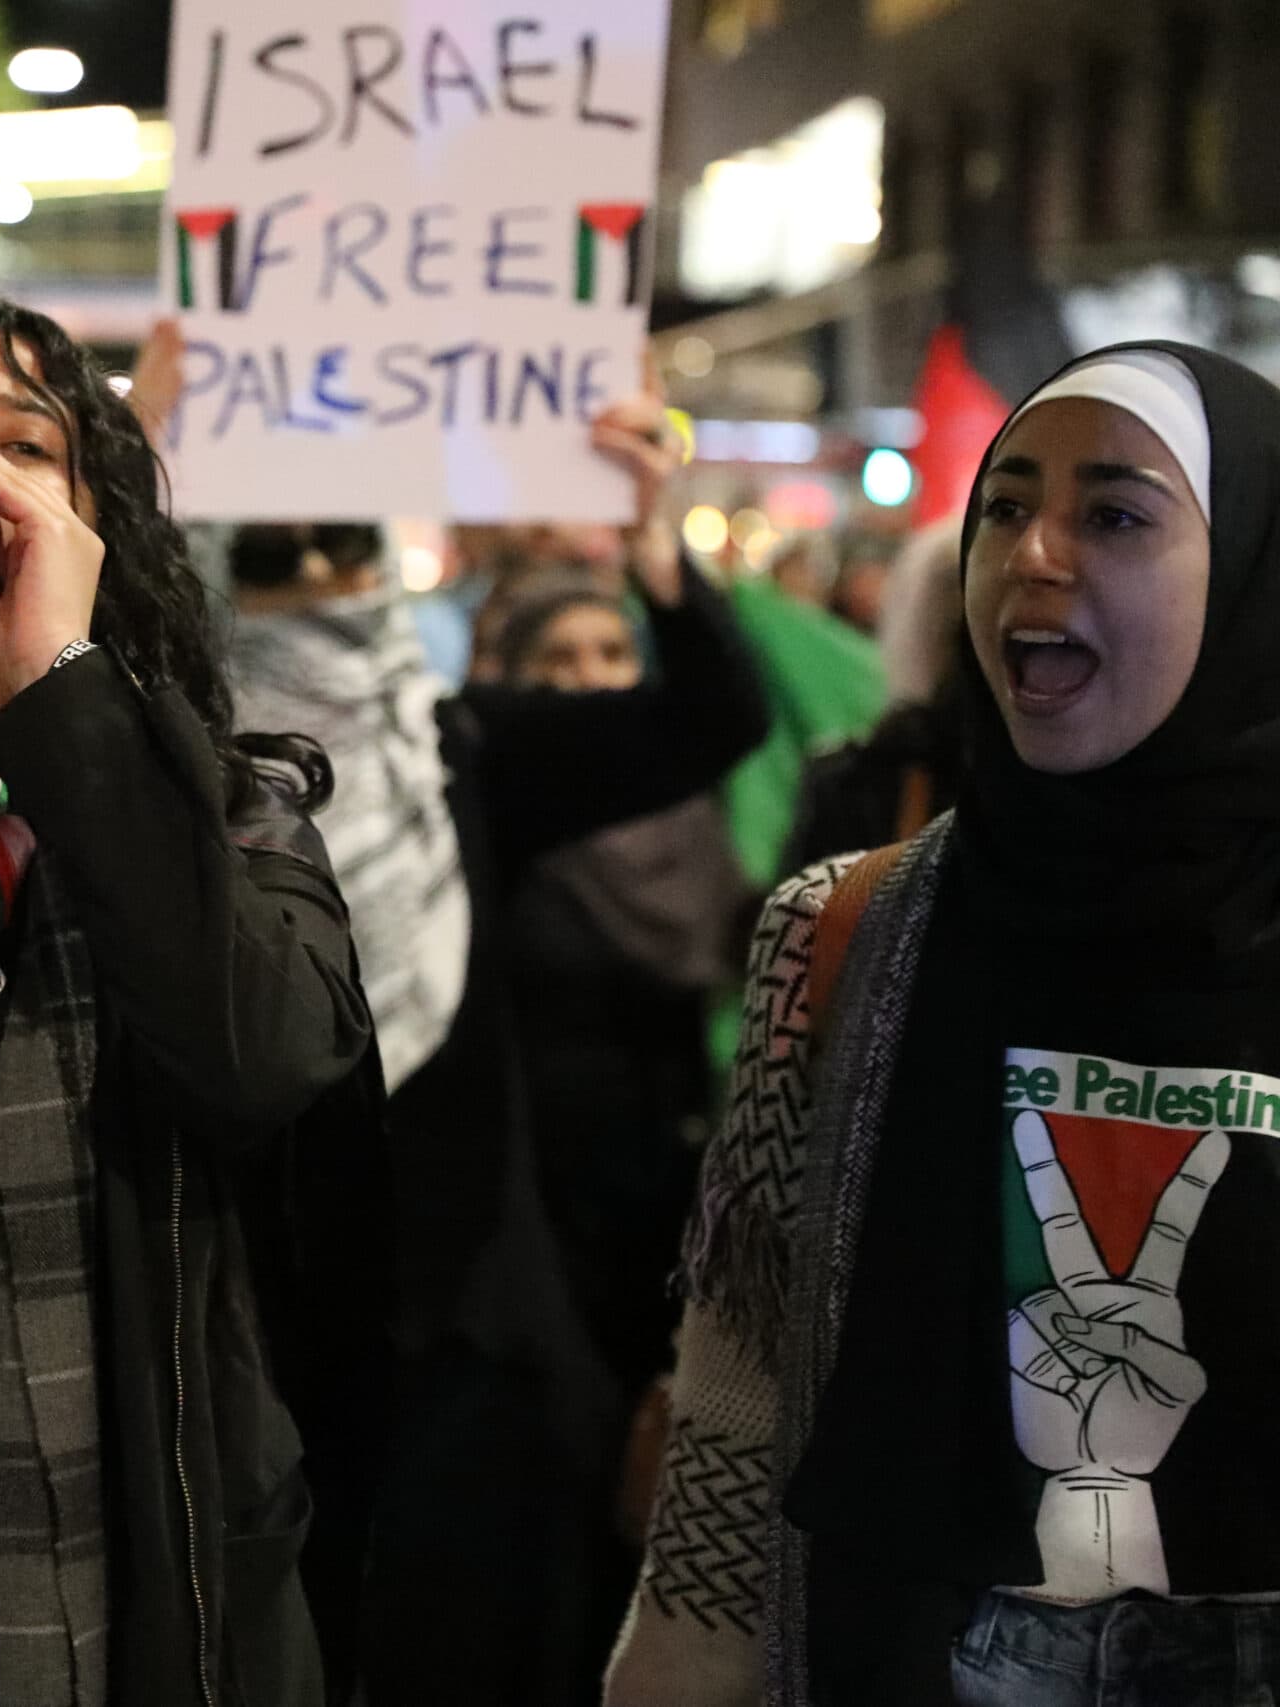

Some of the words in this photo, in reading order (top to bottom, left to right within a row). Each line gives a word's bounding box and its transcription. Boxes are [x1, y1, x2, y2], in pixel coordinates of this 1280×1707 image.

[197, 18, 641, 159] ISRAEL
[234, 192, 556, 311] FREE
[166, 342, 612, 453] PALESTINE
[52, 639, 102, 668] FRE
[1002, 1064, 1060, 1106] ee
[1074, 1057, 1280, 1132] Palestin
